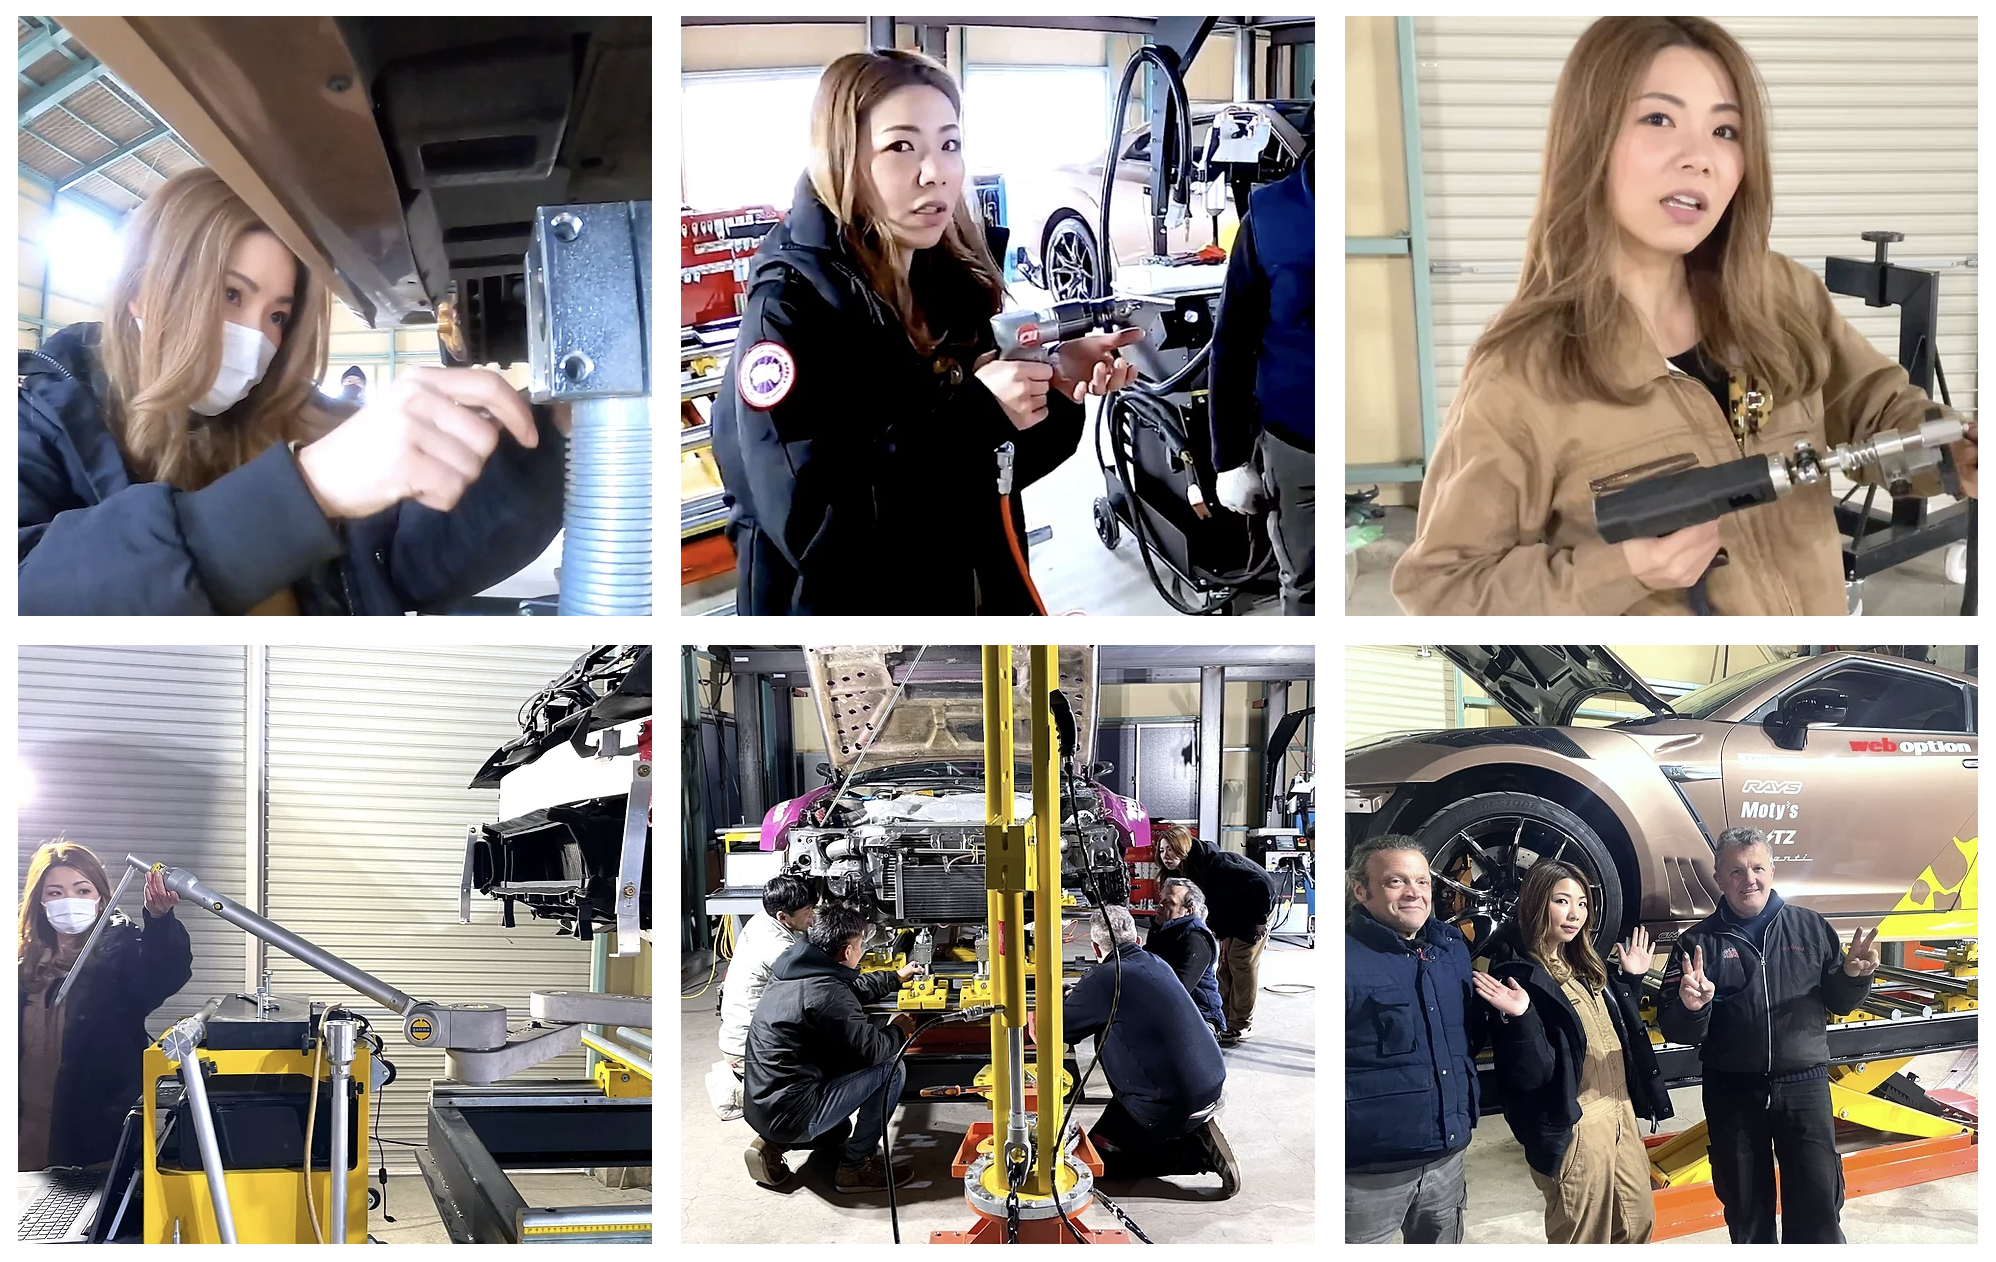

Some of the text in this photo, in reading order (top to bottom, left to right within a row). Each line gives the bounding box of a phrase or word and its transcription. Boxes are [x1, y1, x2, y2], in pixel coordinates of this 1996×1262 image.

[1849, 737, 1972, 756] web option
[1742, 779, 1803, 795] RAYS
[1740, 800, 1799, 820] Moty's
[1772, 853, 1814, 862] anti
